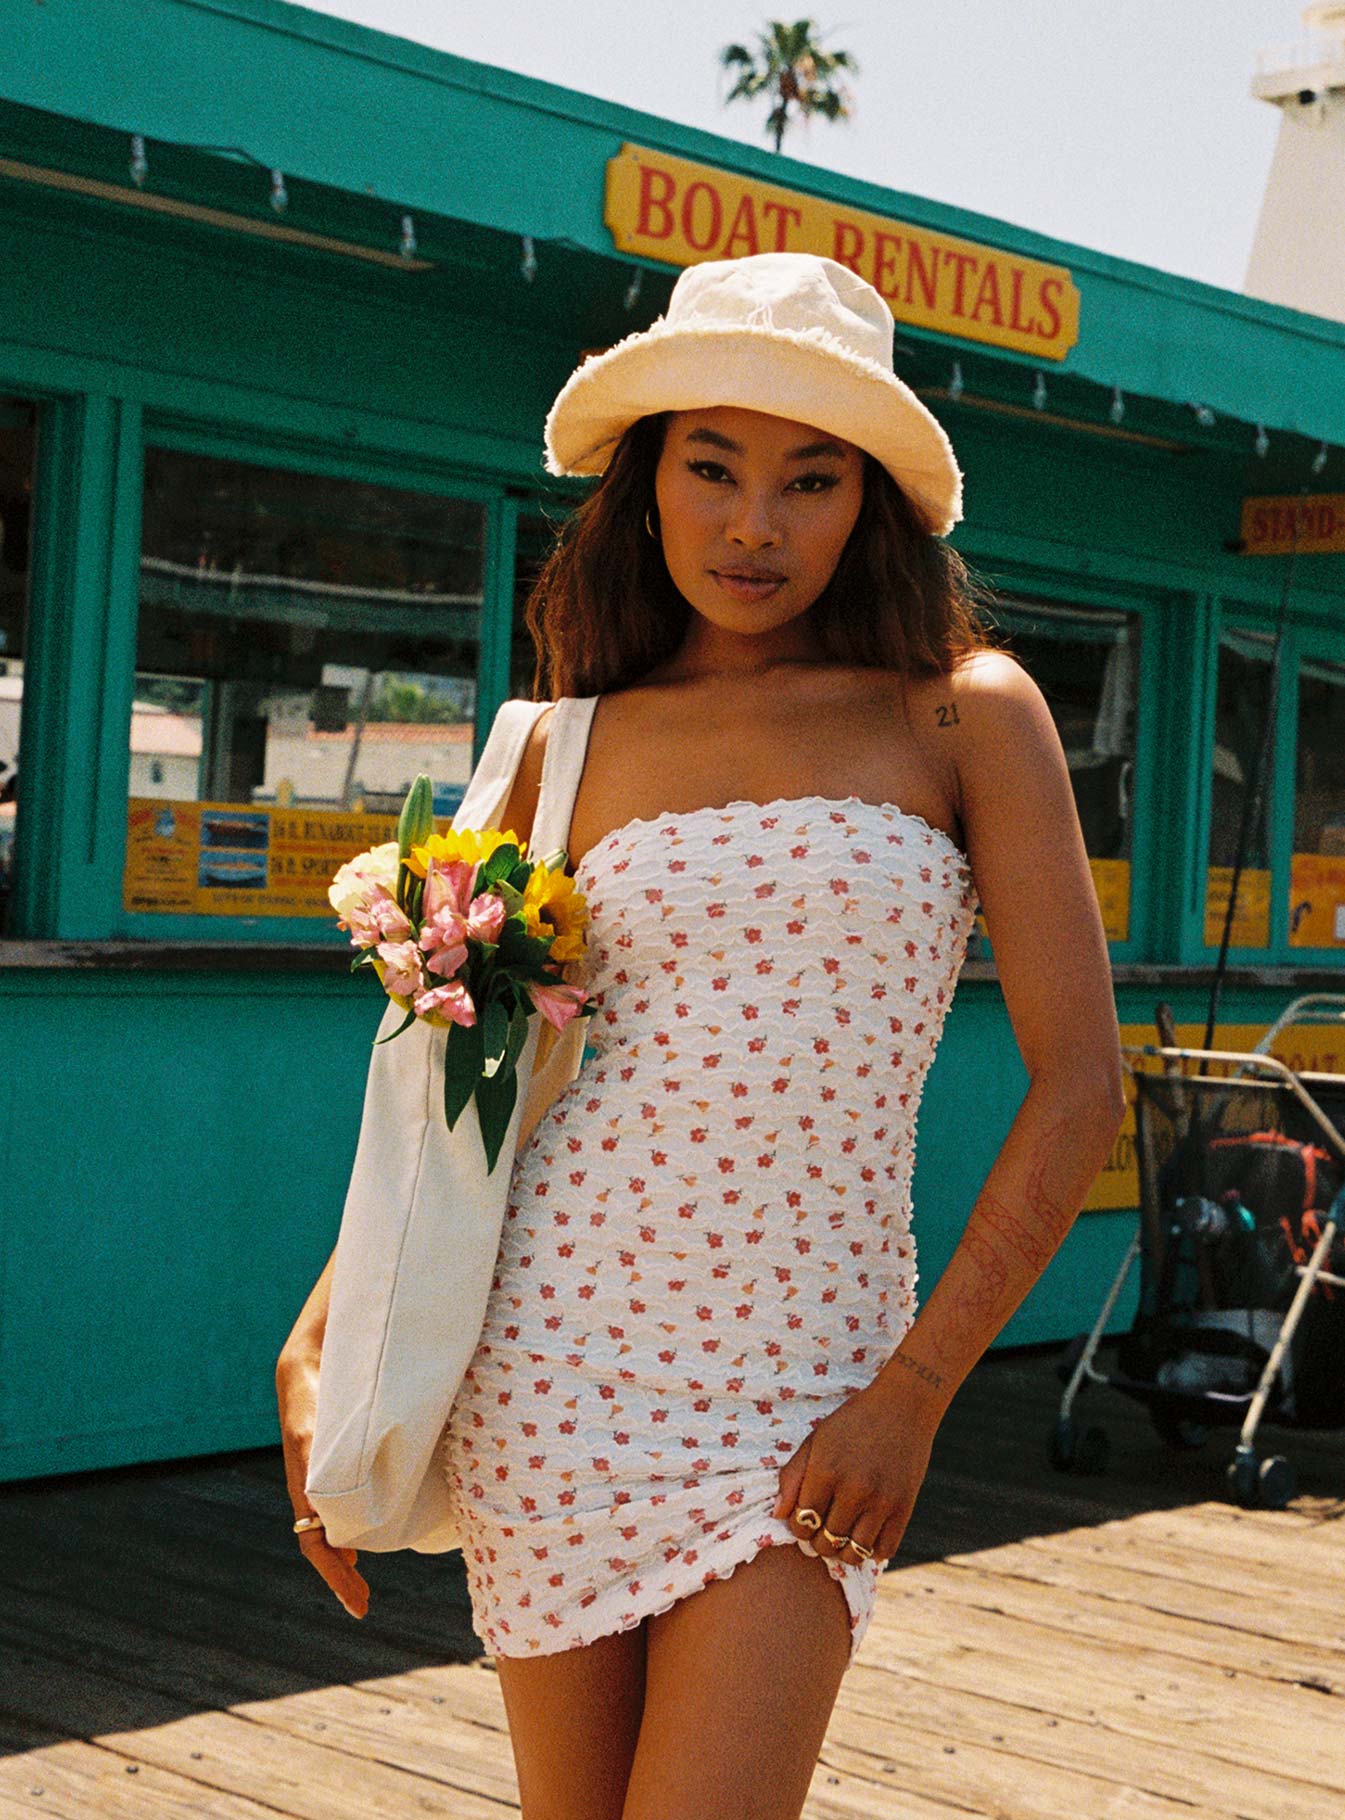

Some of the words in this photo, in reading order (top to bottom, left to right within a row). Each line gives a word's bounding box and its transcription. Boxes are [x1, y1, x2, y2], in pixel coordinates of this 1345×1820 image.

[636, 165, 801, 258] BOAT
[832, 220, 1065, 340] RENTALS
[935, 703, 960, 727] 21
